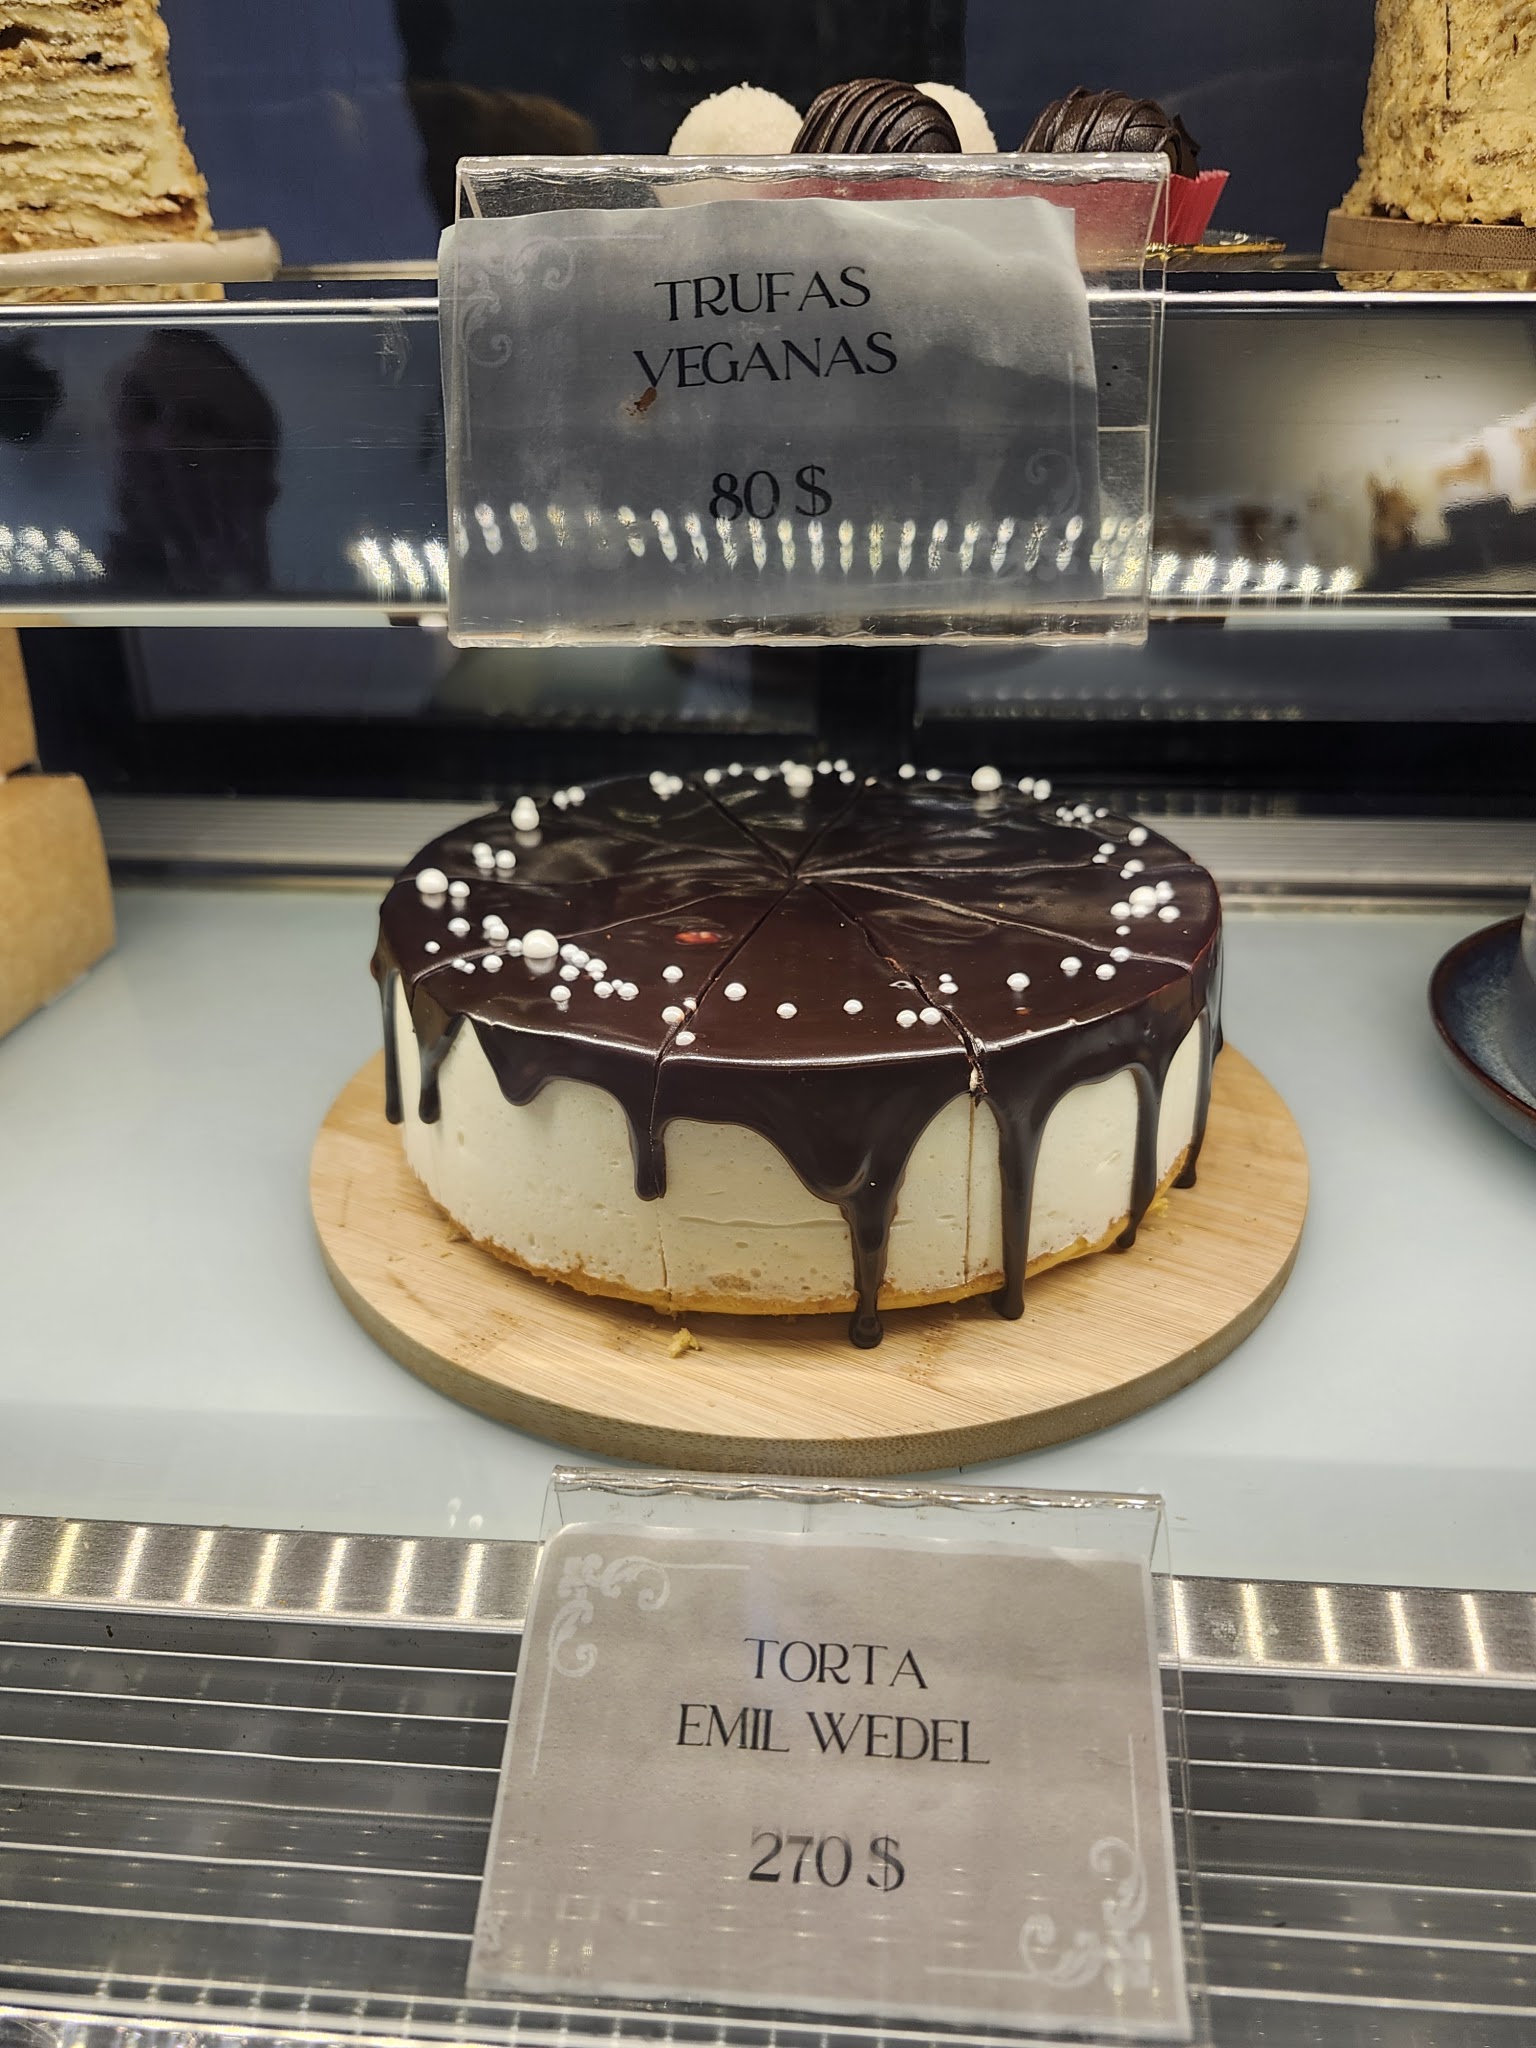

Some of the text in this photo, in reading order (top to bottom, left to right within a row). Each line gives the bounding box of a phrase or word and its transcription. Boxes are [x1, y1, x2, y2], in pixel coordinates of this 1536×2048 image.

[654, 266, 871, 321] TRUFAS
[633, 331, 898, 388] VEGANAS
[708, 470, 780, 521] 80
[744, 1637, 928, 1689] TORTA
[676, 1703, 990, 1764] EMIL WEDEL
[748, 1830, 852, 1887] 270
